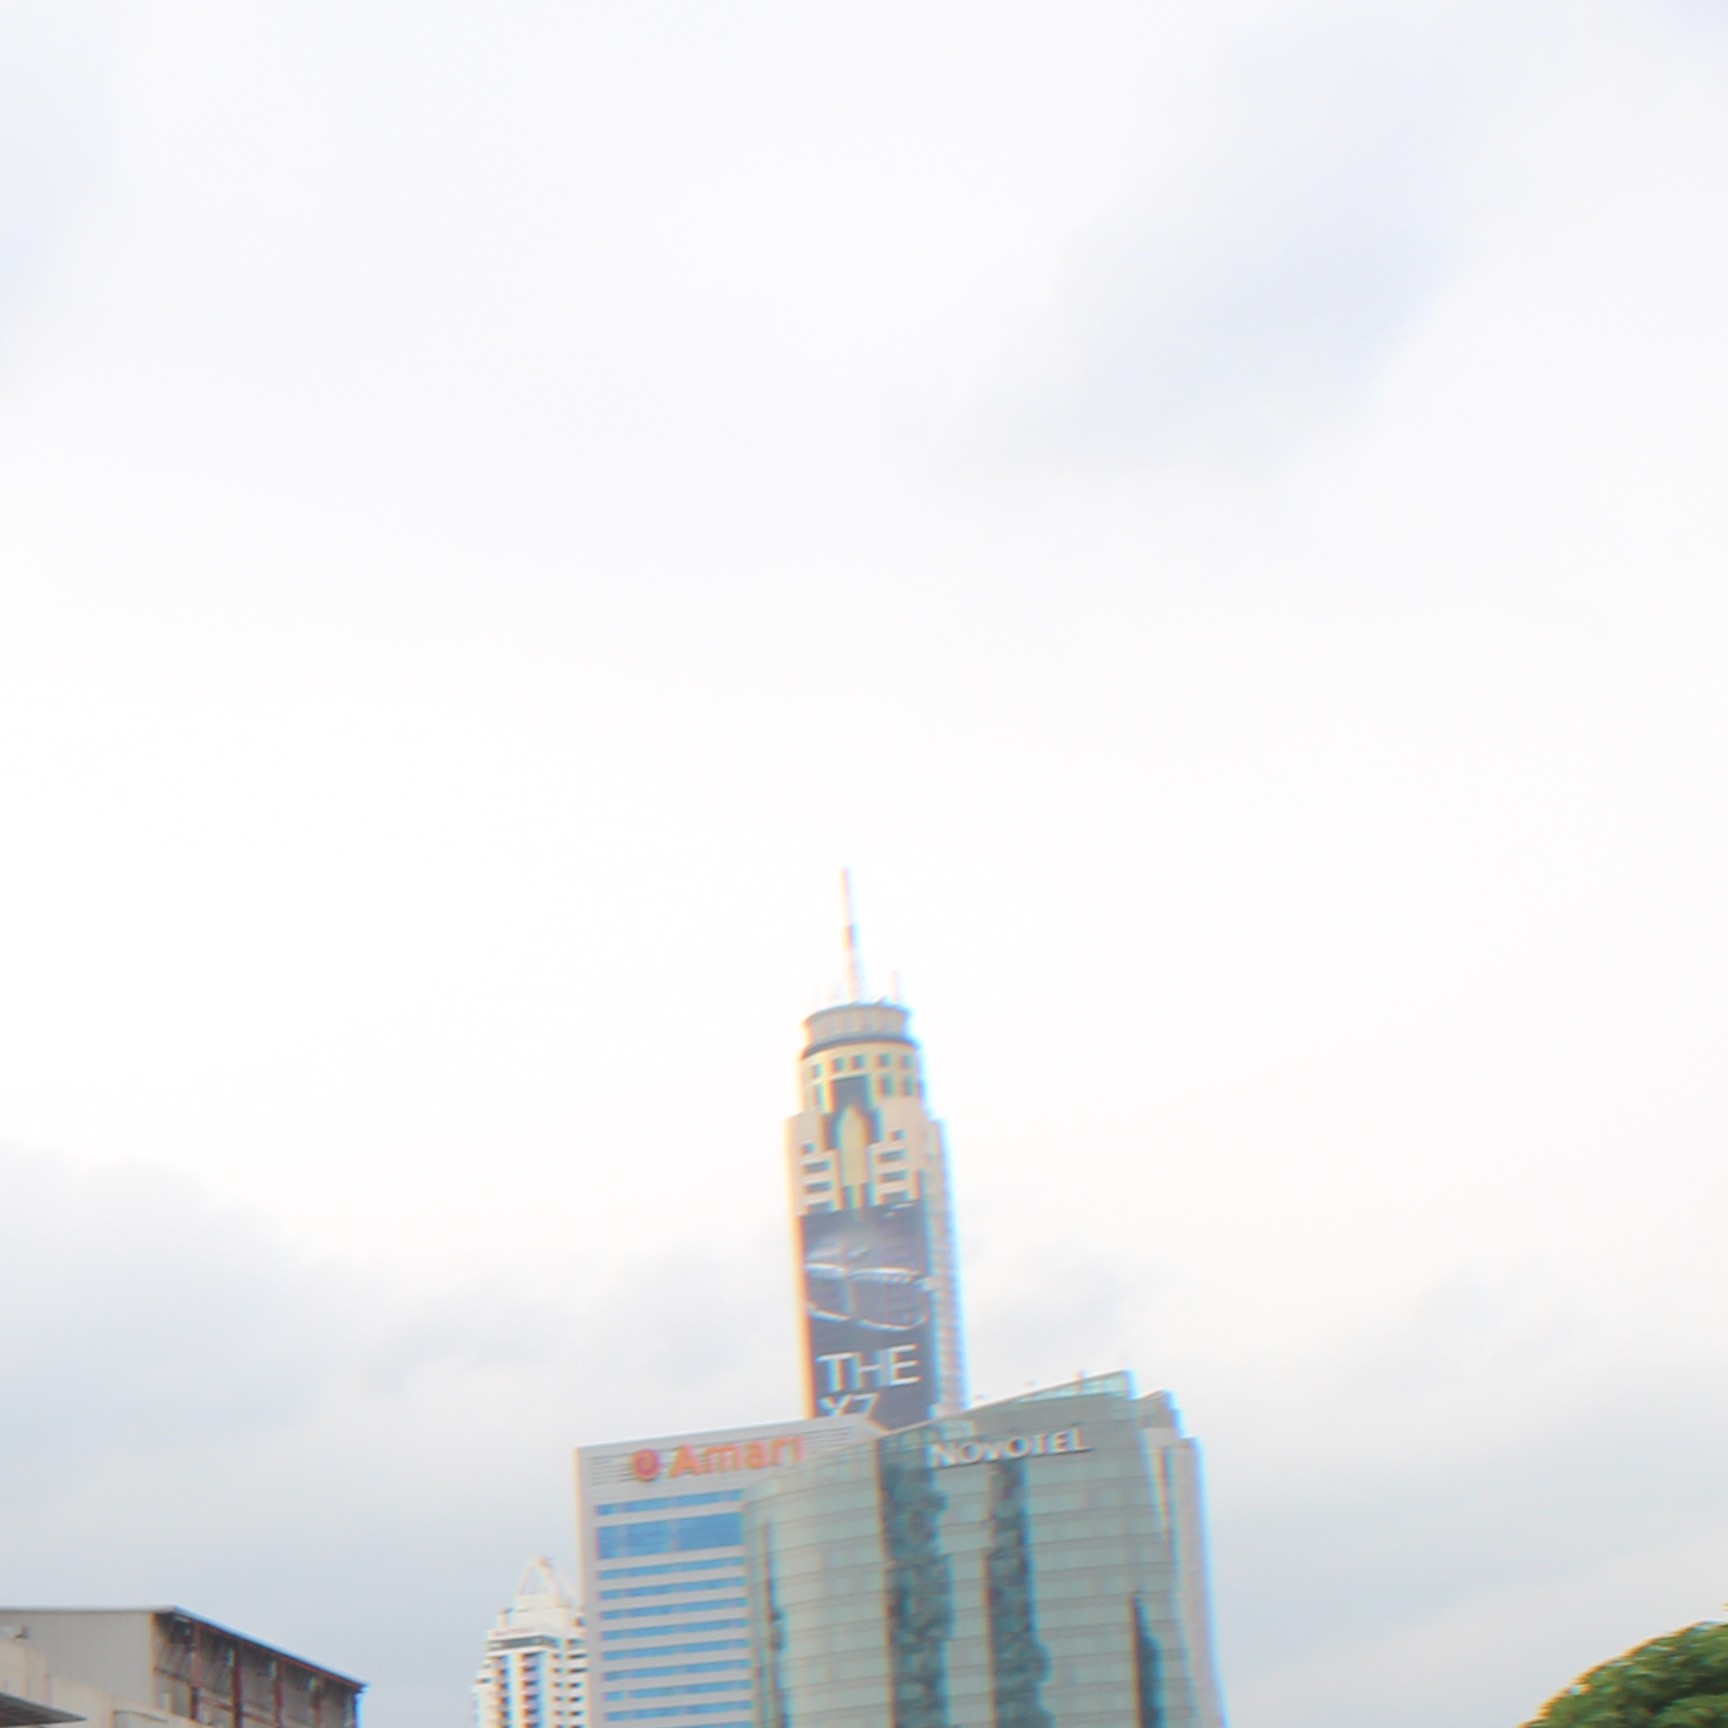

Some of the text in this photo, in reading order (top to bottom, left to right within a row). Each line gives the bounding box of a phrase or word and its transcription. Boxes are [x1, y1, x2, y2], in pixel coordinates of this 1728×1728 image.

[816, 1344, 921, 1391] THE
[669, 1435, 805, 1478] Amari
[931, 1429, 1092, 1467] NOVOTEL
